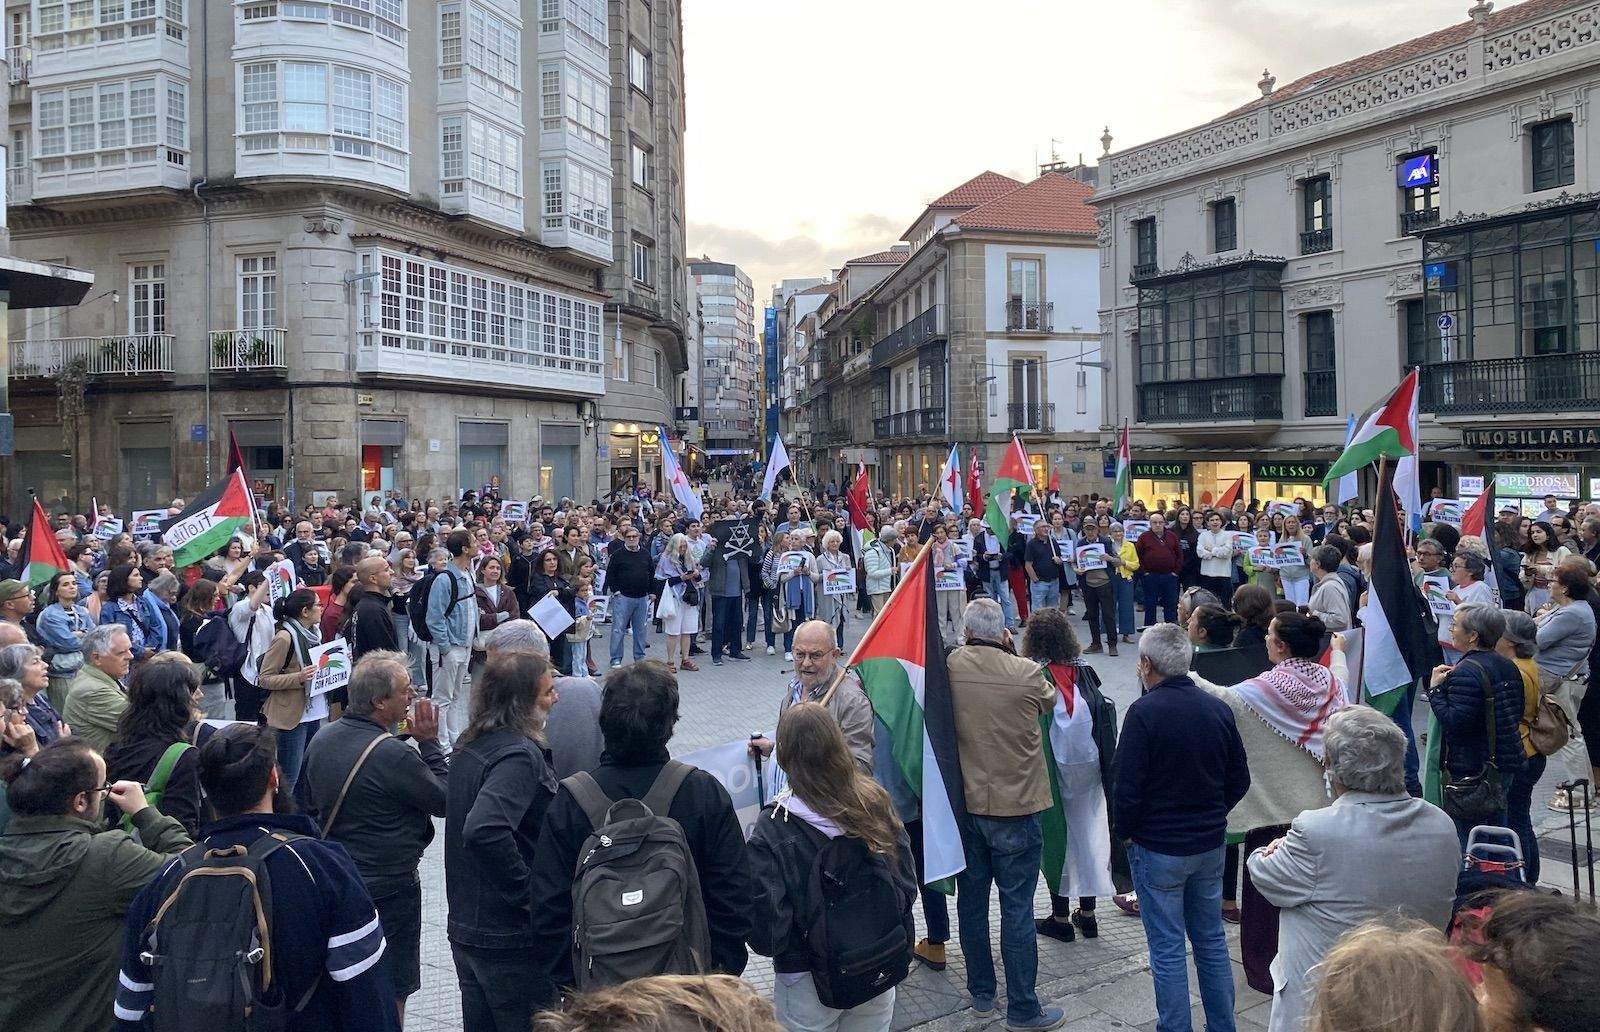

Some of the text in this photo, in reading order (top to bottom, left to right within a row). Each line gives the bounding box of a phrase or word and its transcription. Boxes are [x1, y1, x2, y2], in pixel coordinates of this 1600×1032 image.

[1408, 167, 1428, 181] AXA
[1136, 465, 1181, 475] ARESSO
[1259, 466, 1316, 477] ARESSO
[1509, 476, 1570, 486] PEDROSA
[325, 671, 347, 686] PALESTINA
